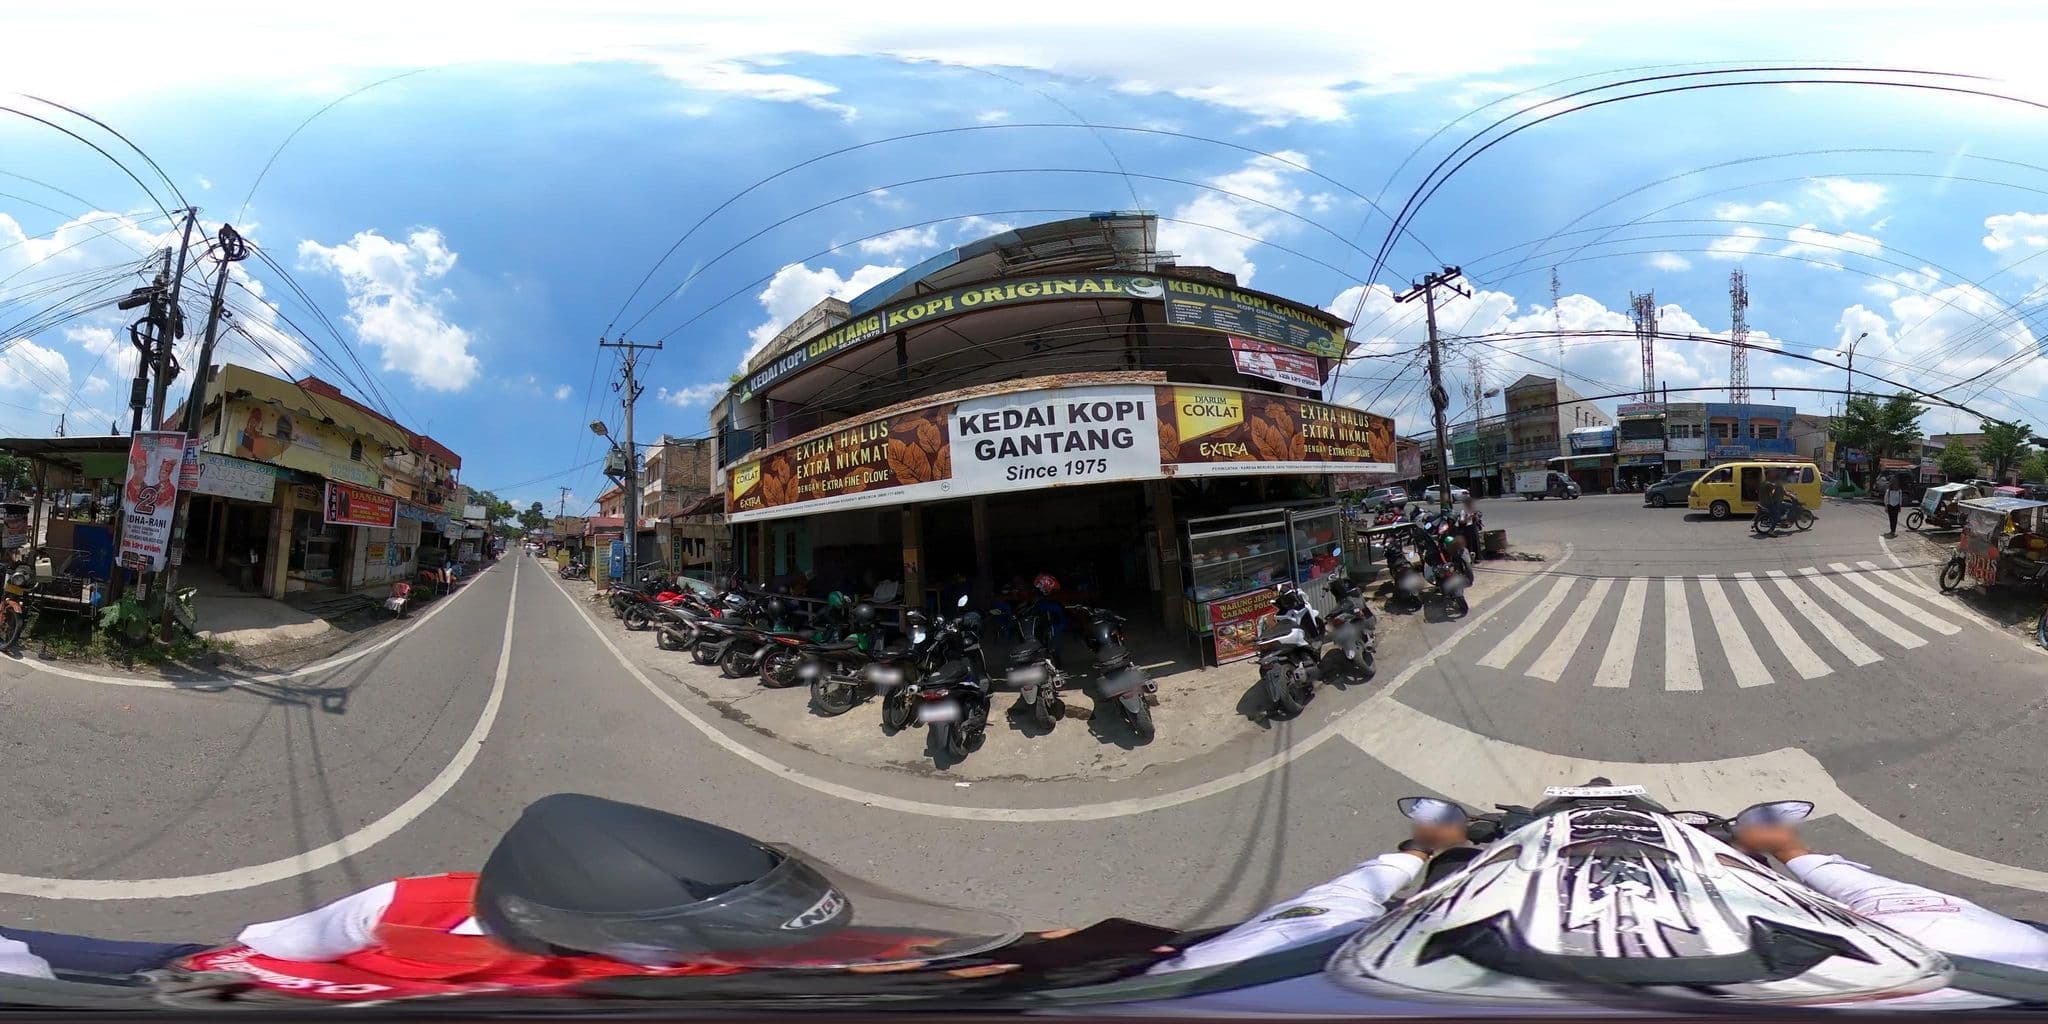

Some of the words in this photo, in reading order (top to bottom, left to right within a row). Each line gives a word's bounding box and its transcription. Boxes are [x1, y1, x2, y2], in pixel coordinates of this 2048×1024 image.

[888, 296, 954, 327] KOPI
[961, 278, 1122, 306] ORIGINAL
[1168, 280, 1224, 299] KEDAI
[1230, 290, 1268, 310] KOPI
[1273, 303, 1329, 330] GANTANG
[1236, 304, 1254, 313] KOPI
[1255, 308, 1288, 322] ORIGINAL
[838, 336, 861, 350] SEJAK
[863, 329, 881, 341] 1975
[750, 368, 778, 392] KEDAI
[780, 346, 807, 374] KOPI
[809, 315, 880, 358] GANTANG
[1195, 395, 1227, 405] DJARUM
[959, 405, 1056, 437] KEDAI
[1068, 400, 1145, 424] KOPI
[1182, 404, 1239, 418] COKLAT
[1300, 404, 1337, 423] EXTRA
[1341, 411, 1369, 428] HALUS
[796, 437, 834, 461] EXTRA
[840, 421, 889, 448] HALUS
[974, 427, 1134, 461] GANTANG
[1302, 424, 1336, 440] EXTRA
[1339, 428, 1370, 443] NIKMAT
[1200, 442, 1249, 457] EXTRA
[1304, 445, 1326, 453] DENGAN
[1328, 445, 1345, 456] EXTRA
[1345, 448, 1356, 457] FINE
[797, 458, 831, 480] EXTRA
[836, 443, 889, 470] NIKMAT
[1006, 464, 1058, 481] Since
[1063, 458, 1107, 476] 1975
[736, 470, 759, 485] COKLAT
[798, 481, 820, 494] DENGAN
[822, 478, 844, 492] EXTRA
[845, 476, 860, 488] FINE
[863, 469, 889, 484] CLOVE
[740, 495, 762, 509] EXTRA
[1220, 598, 1253, 612] WARUNG
[1253, 592, 1272, 602] JENG
[1222, 606, 1253, 619] CABANG
